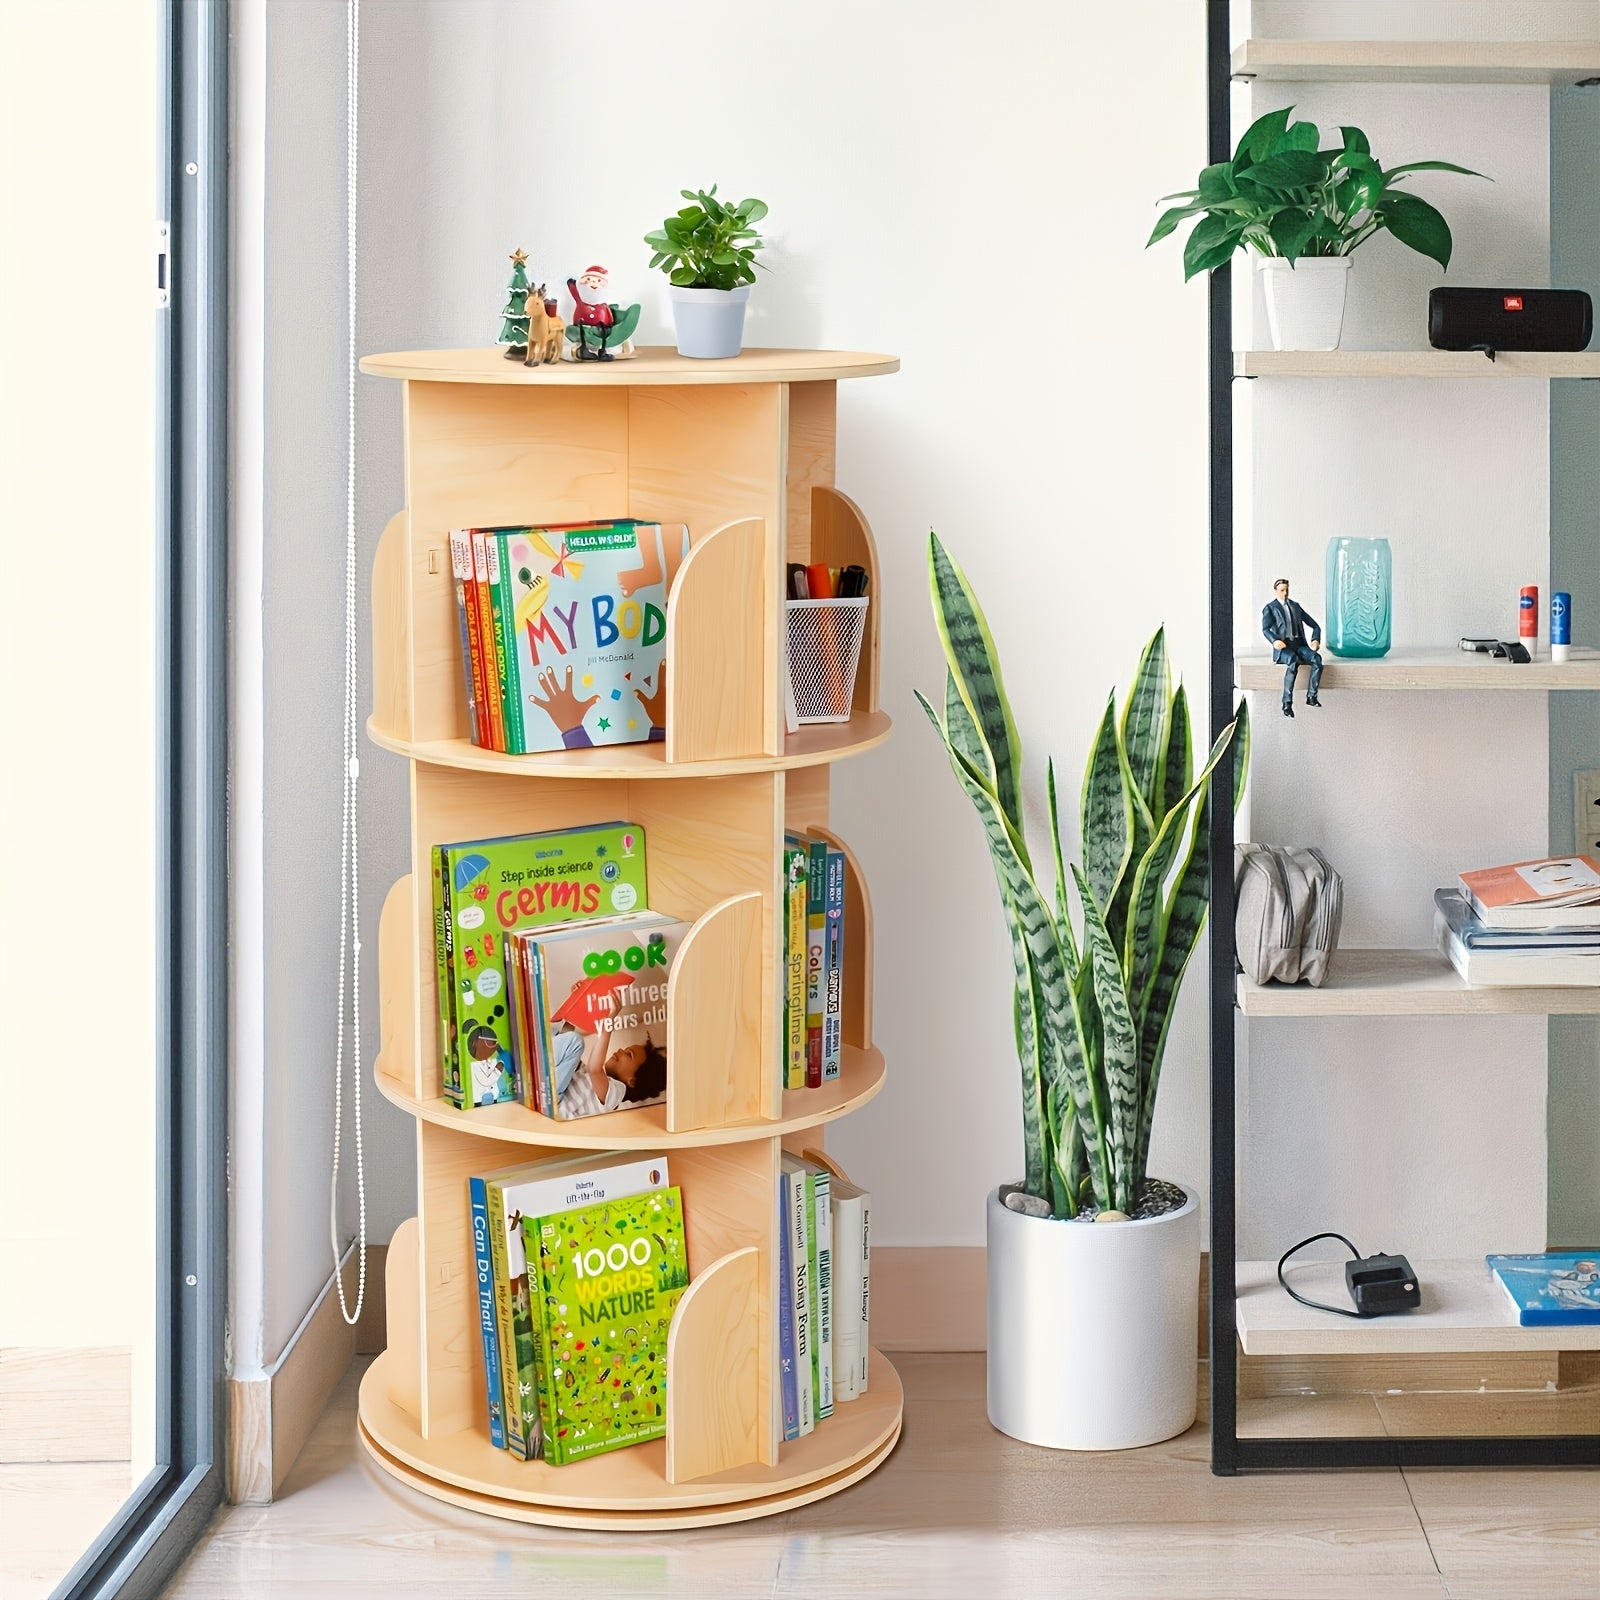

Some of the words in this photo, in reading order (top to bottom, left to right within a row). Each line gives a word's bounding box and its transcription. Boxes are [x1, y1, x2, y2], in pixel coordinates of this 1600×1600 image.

[569, 536, 598, 547] HELLO,
[599, 533, 633, 545] WORLD!
[466, 602, 479, 645] SOLAR
[494, 622, 504, 643] MY
[526, 600, 578, 666] MY
[592, 594, 668, 649] BOD
[478, 586, 493, 660] RAINFOREST
[486, 663, 499, 716] ANIMALS
[497, 647, 507, 681] BODY
[598, 653, 635, 664] McDonald
[501, 870, 525, 886] Step
[527, 864, 555, 879] inside
[557, 860, 594, 875] science
[436, 906, 445, 934] YOUR
[438, 939, 446, 968] BODY
[809, 945, 823, 999] Colors
[594, 1014, 638, 1038] years
[643, 1004, 668, 1026] old
[474, 1216, 487, 1252] Can
[796, 1204, 805, 1249] Campbell
[478, 1259, 490, 1283] Do
[571, 1236, 653, 1279] 1000
[819, 1249, 831, 1289] MOUNTAIN
[527, 1261, 539, 1293] 1000
[574, 1265, 655, 1303] WORDS
[796, 1264, 807, 1310] Noisy
[480, 1290, 494, 1331] That!
[578, 1288, 656, 1327] NATURE
[798, 1313, 809, 1357] Farm
